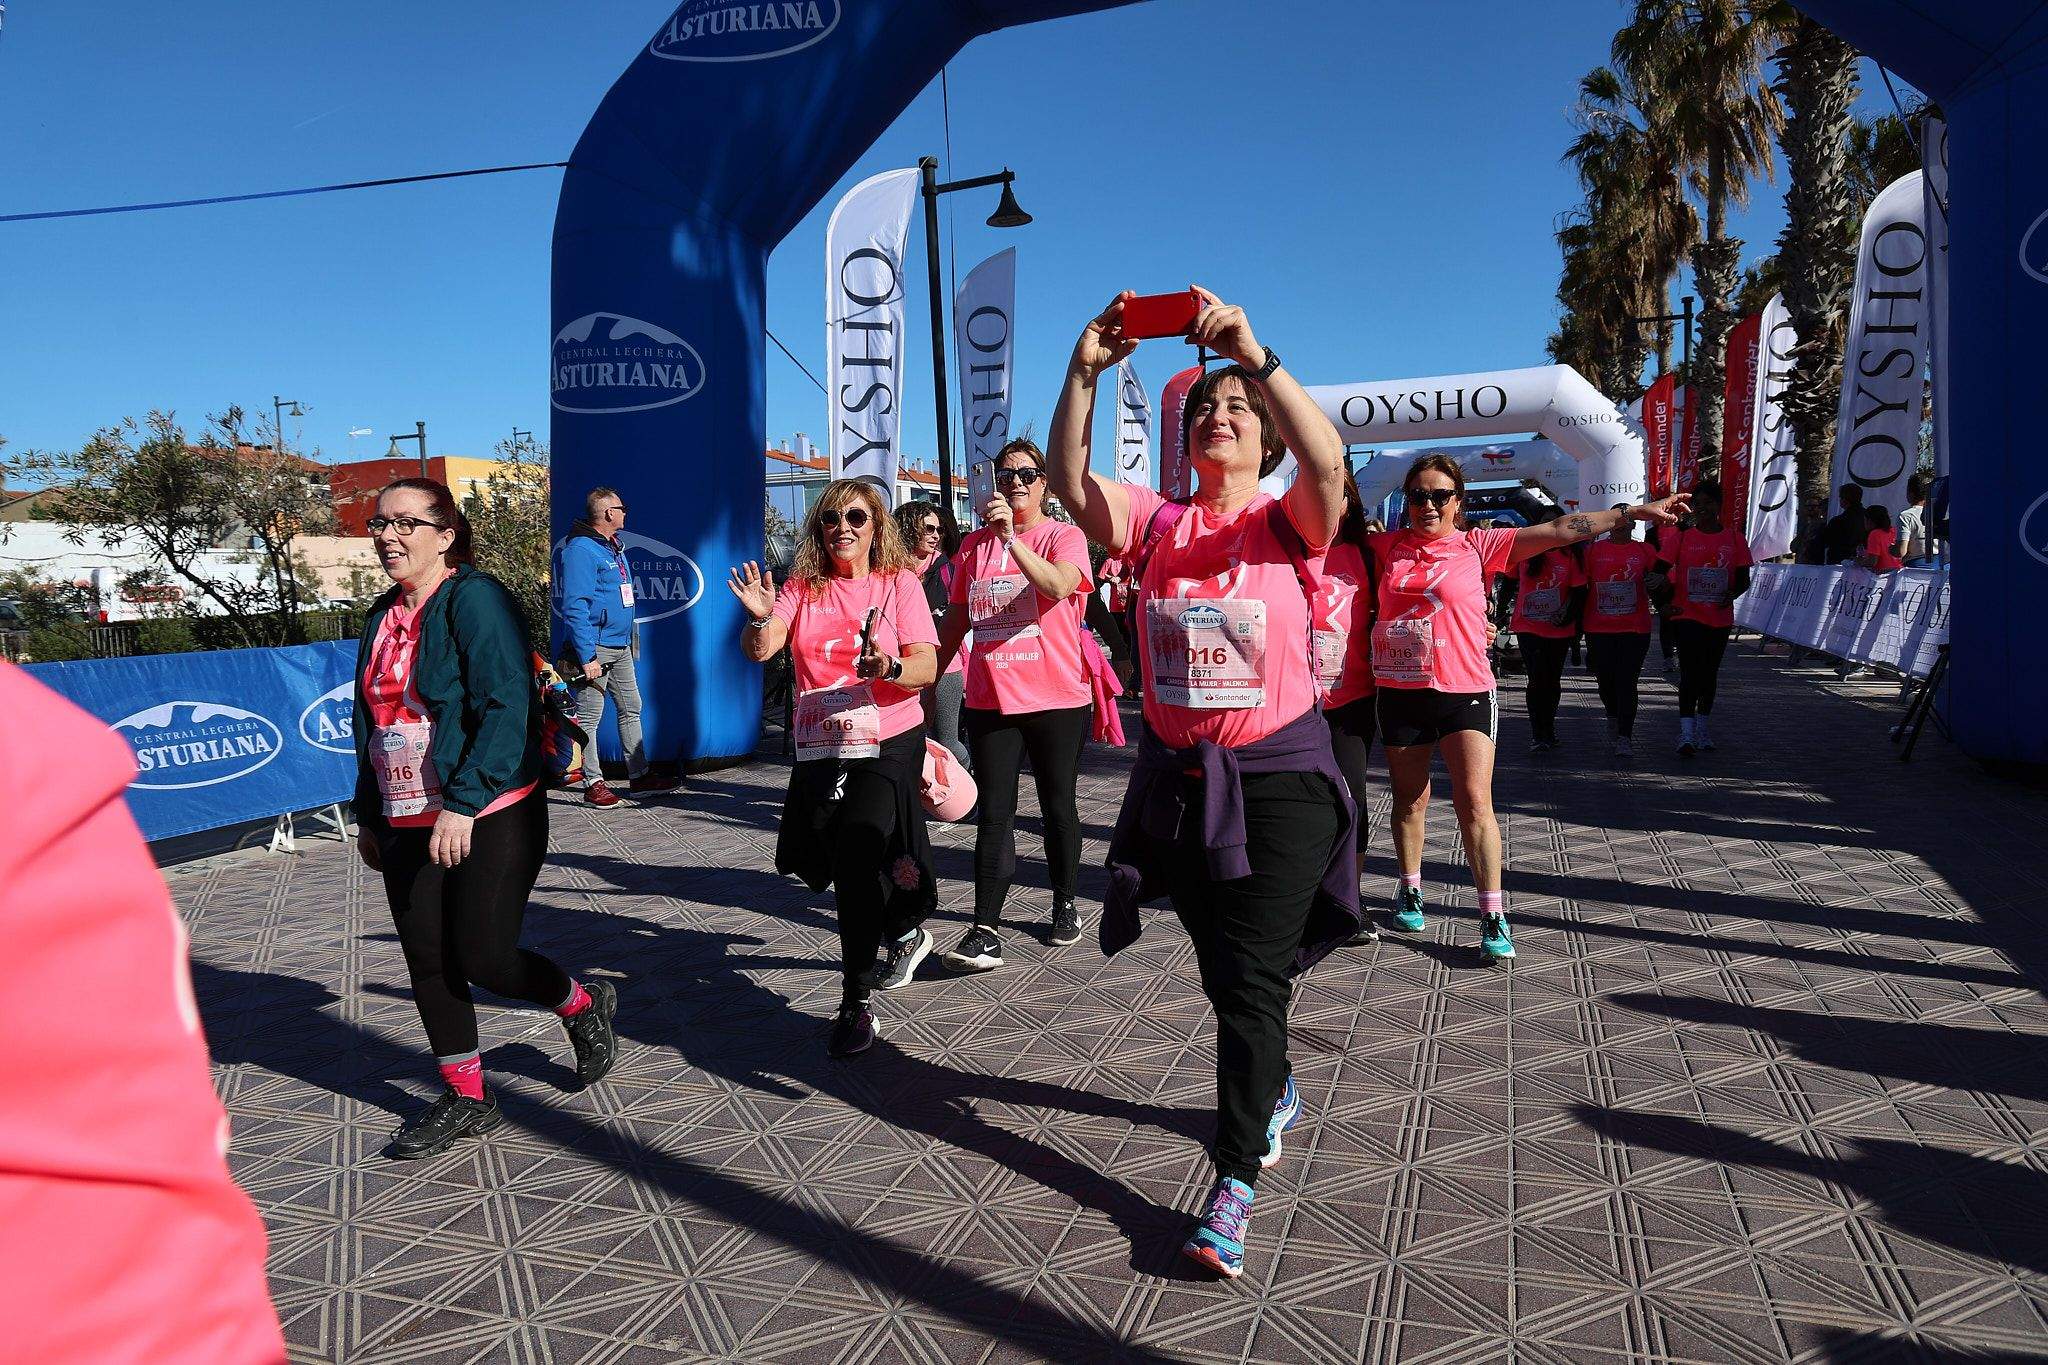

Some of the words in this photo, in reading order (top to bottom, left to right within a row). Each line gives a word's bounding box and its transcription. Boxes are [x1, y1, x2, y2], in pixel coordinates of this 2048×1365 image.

[657, 1, 825, 48] ASTURIANA
[560, 347, 608, 361] CENTRAL
[615, 347, 683, 359] LECHERA
[1847, 221, 1926, 489] OYSHO
[551, 356, 691, 393] ASTURIANA
[1340, 385, 1508, 428] OYSHO
[1558, 412, 1612, 428] OYSHO
[1655, 400, 1668, 473] Santander
[1589, 481, 1640, 497] OYSHO
[630, 561, 682, 571] CHERA
[992, 603, 1017, 616] 016
[1181, 614, 1224, 624] ASTURIANA
[996, 652, 1005, 661] DE
[1006, 652, 1014, 661] LA
[1015, 651, 1040, 661] MUJER
[1185, 648, 1227, 665] 016
[1390, 648, 1412, 659] 016
[1191, 669, 1212, 678] 8371
[1166, 689, 1191, 701] OYSHO
[134, 728, 197, 745] CENTRAL
[201, 721, 259, 736] LECHERA
[822, 718, 854, 732] 016
[136, 733, 273, 771] STURIANA
[385, 765, 413, 782] 016
